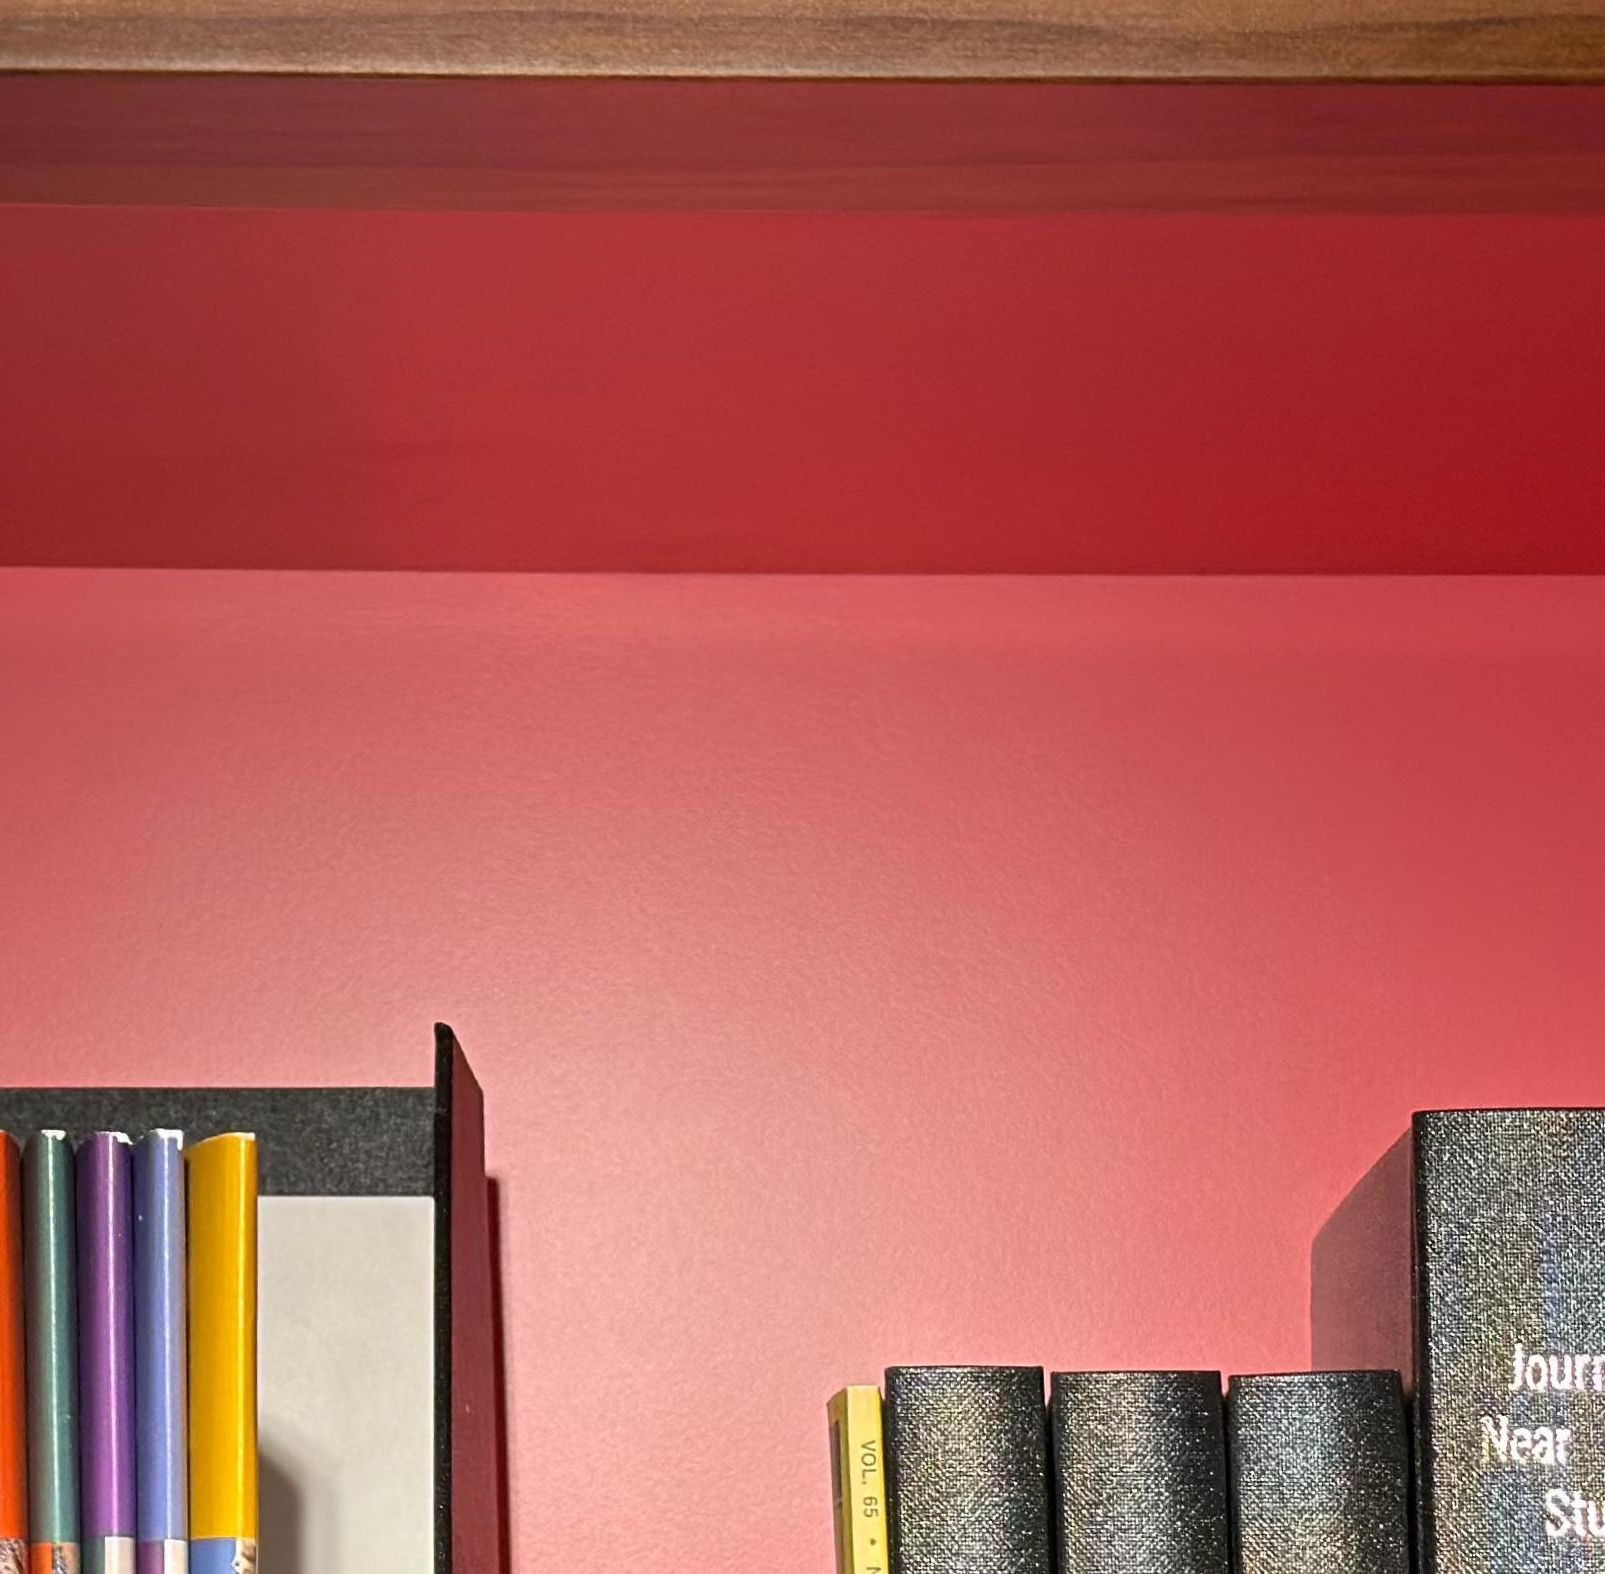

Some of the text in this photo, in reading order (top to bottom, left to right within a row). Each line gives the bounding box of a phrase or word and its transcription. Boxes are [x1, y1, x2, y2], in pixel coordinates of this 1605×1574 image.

[860, 1440, 877, 1485] VOL.
[1479, 1414, 1572, 1466] Near
[863, 1496, 880, 1518] 65
